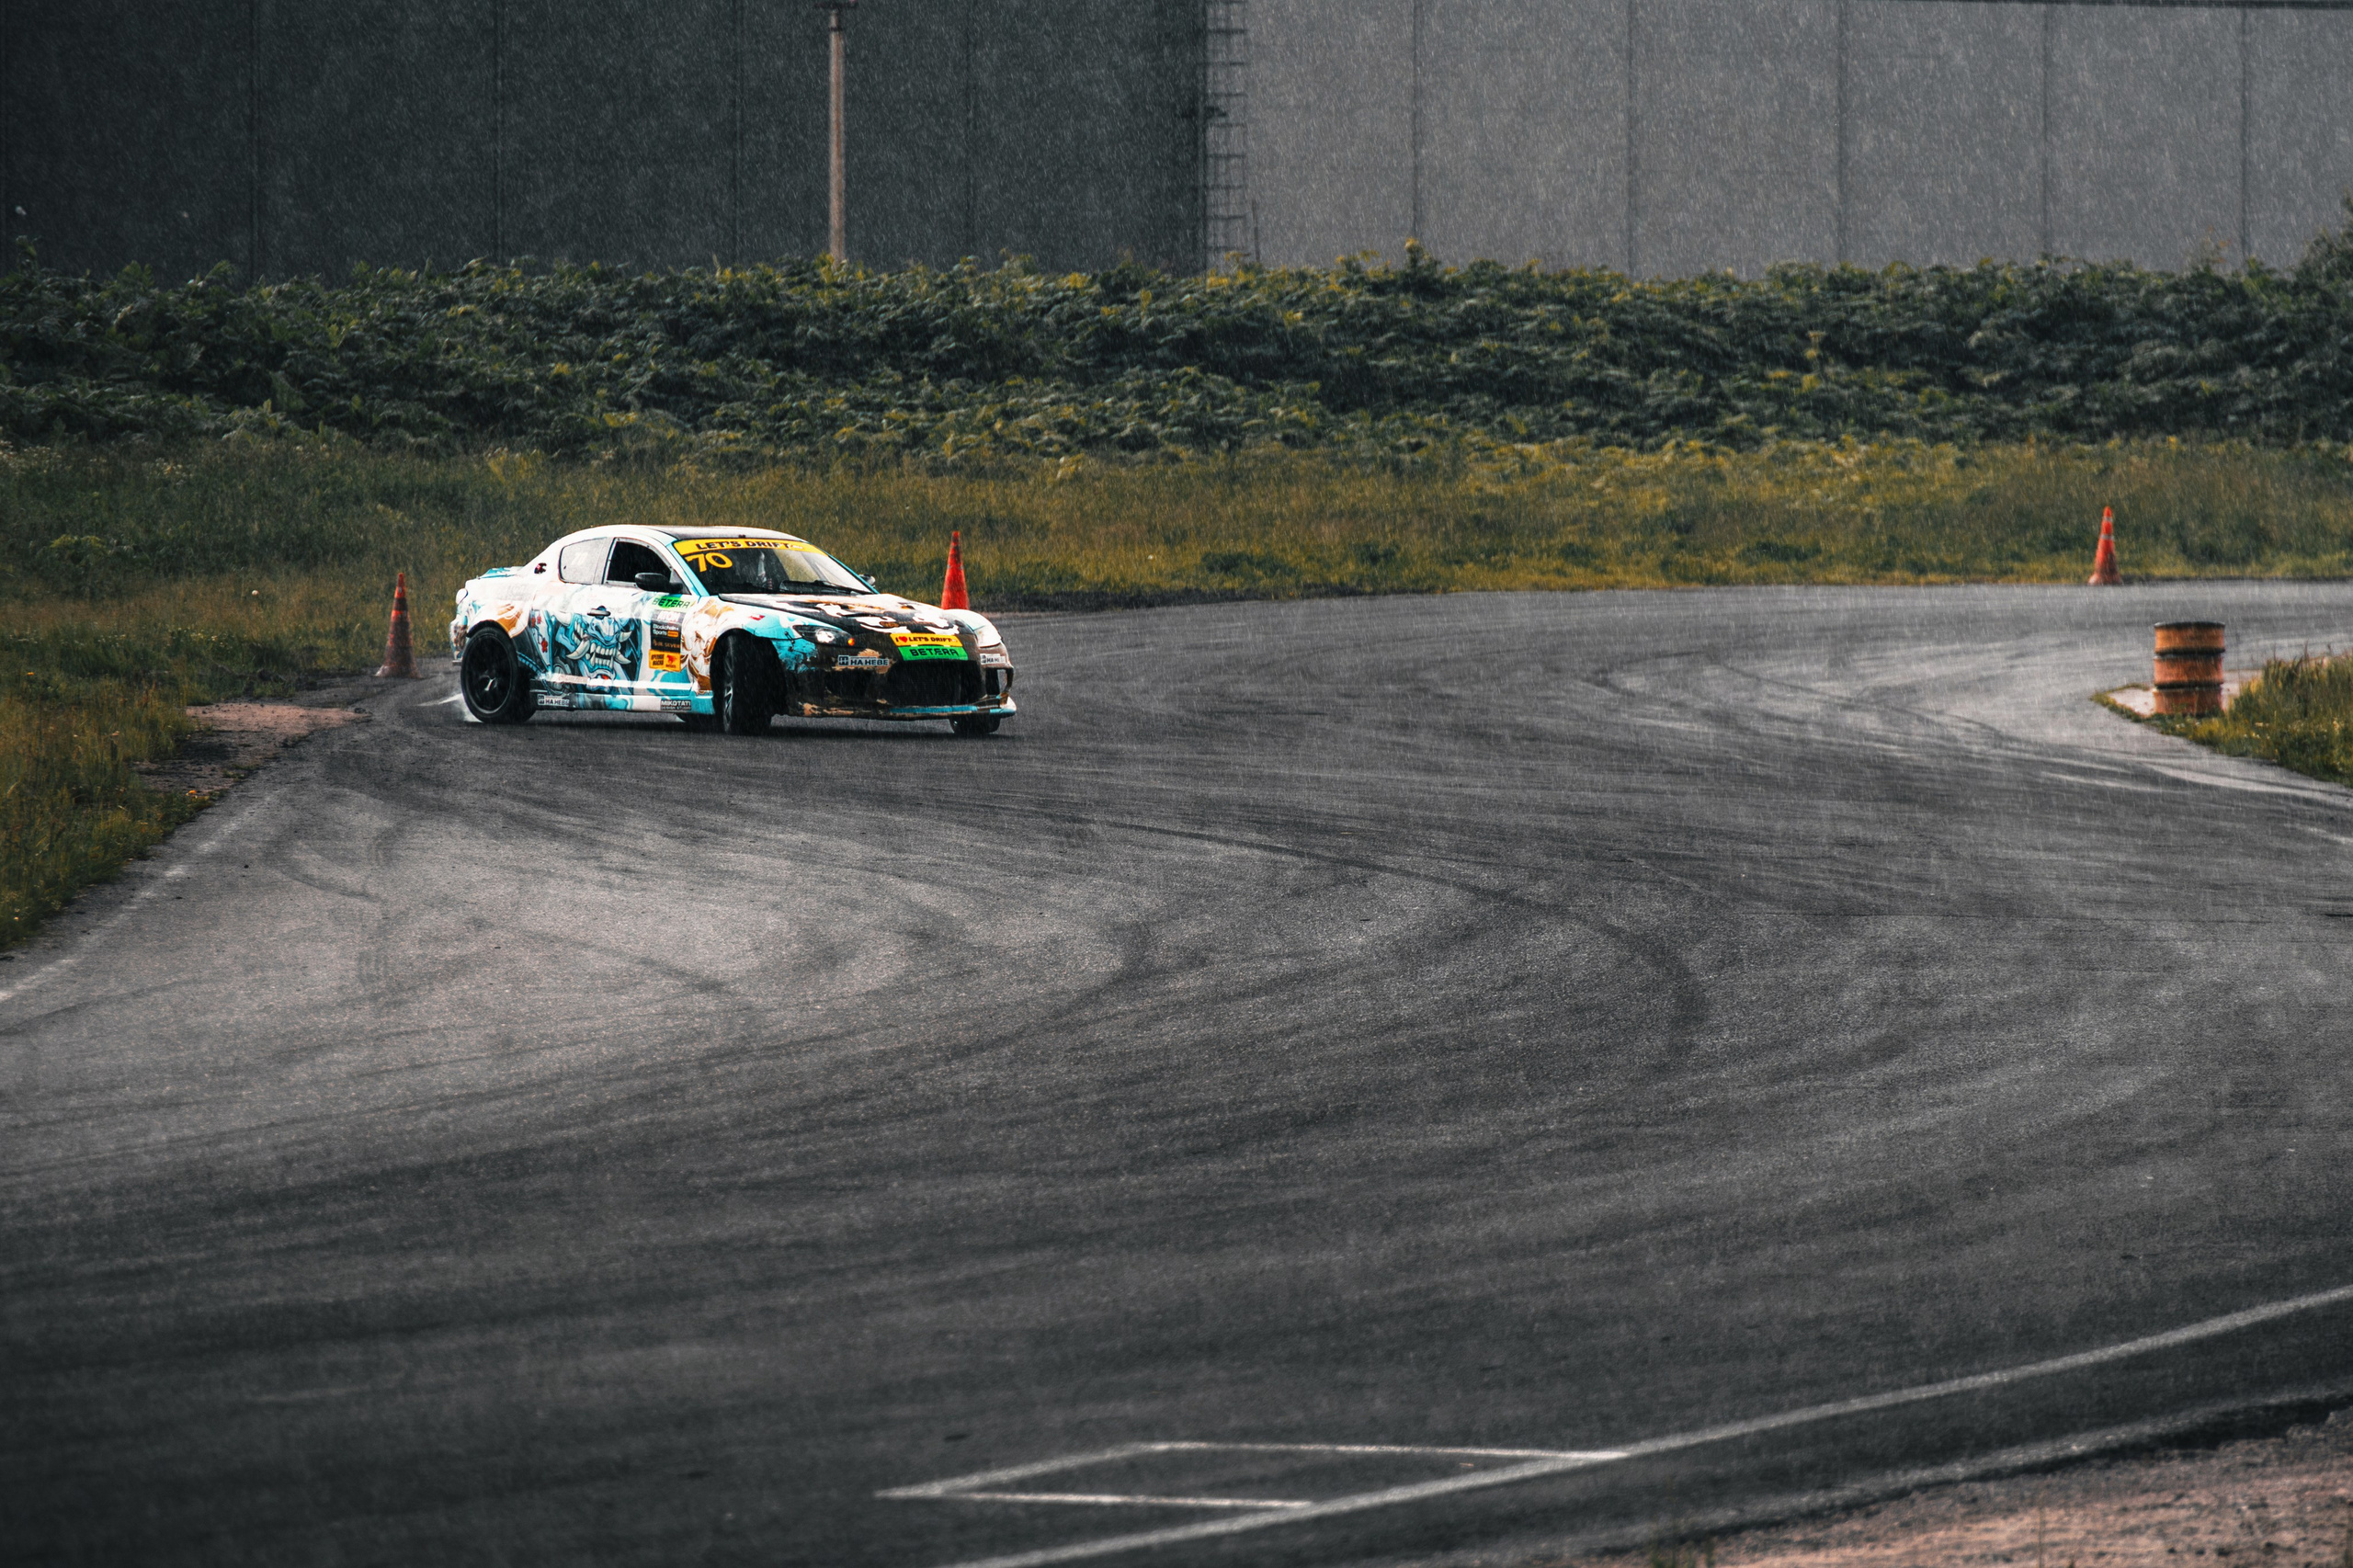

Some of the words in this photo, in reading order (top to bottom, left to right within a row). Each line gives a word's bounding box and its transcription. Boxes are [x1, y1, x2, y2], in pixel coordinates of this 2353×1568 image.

[696, 541, 741, 550] LET'S
[745, 540, 790, 549] DRIFT
[684, 552, 733, 573] 70
[910, 648, 959, 656] BETERA
